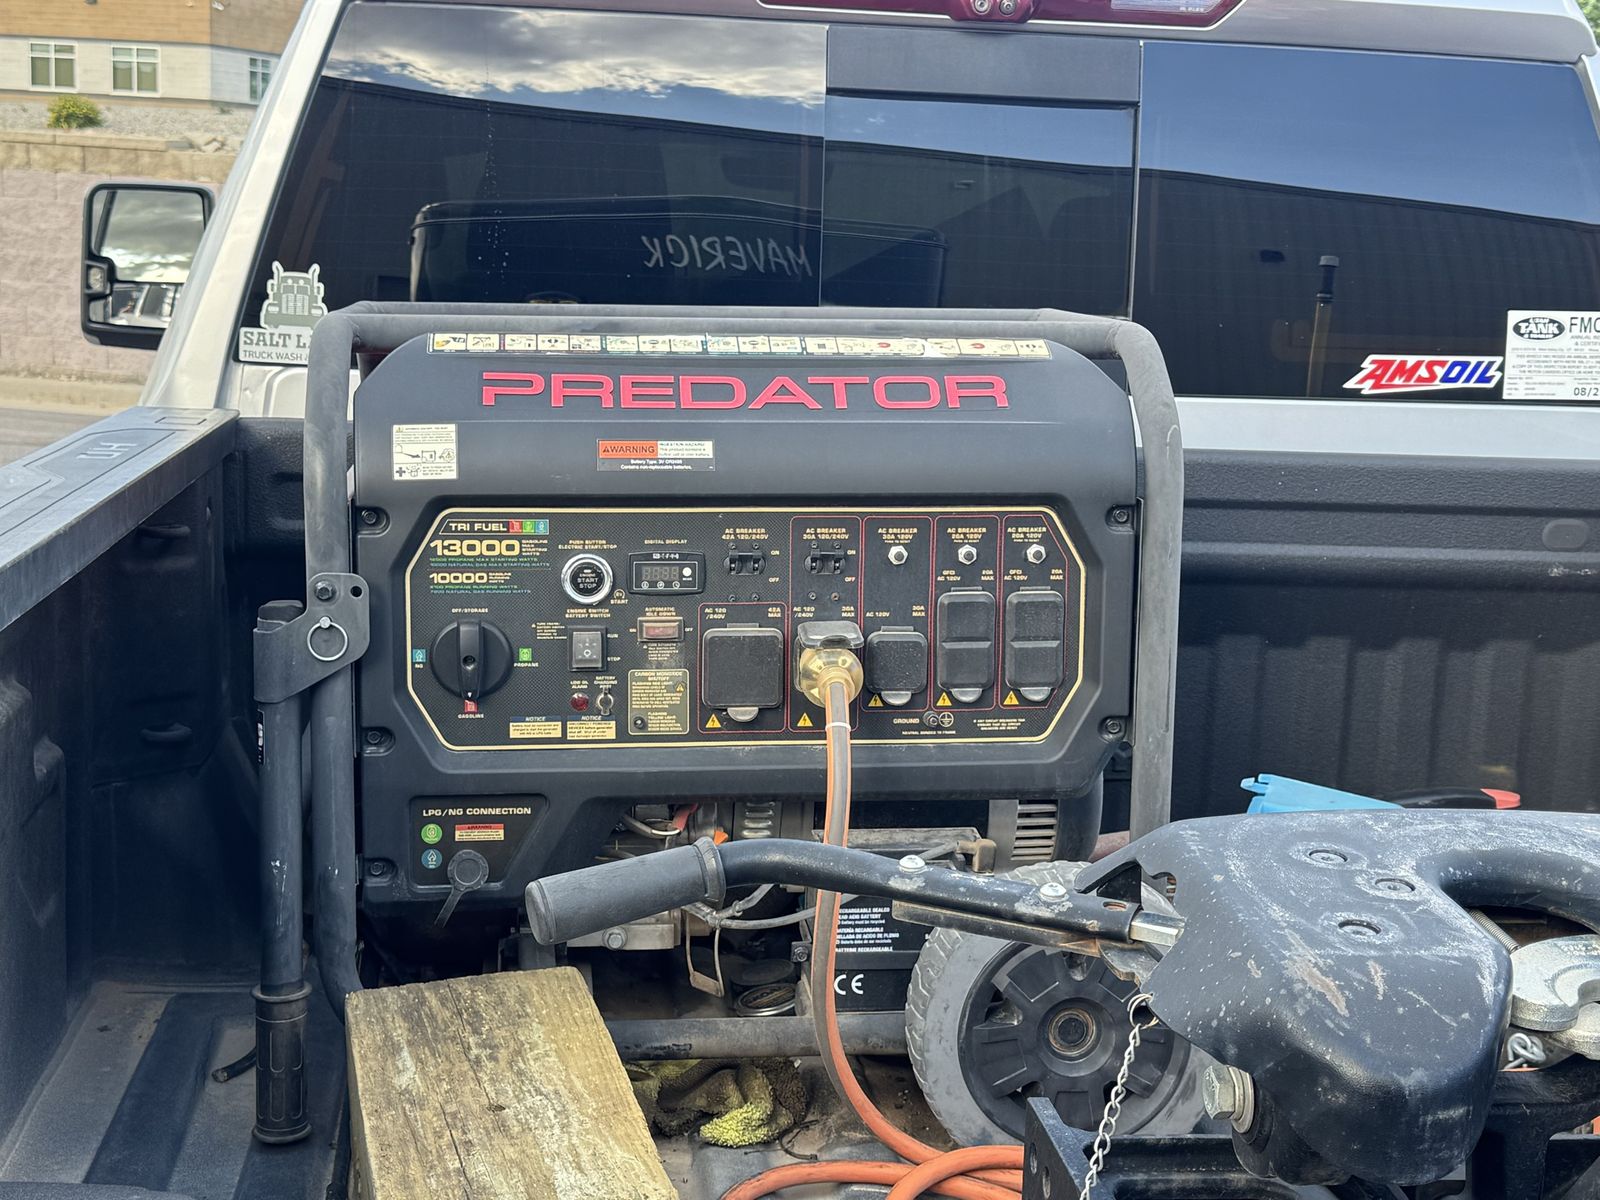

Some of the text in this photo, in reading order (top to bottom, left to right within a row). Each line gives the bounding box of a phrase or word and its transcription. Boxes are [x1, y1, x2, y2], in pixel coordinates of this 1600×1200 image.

[1518, 322, 1559, 334] TANK
[243, 331, 310, 349] SALT L
[243, 350, 274, 359] TRUCK
[275, 351, 302, 360] WASH
[1354, 359, 1497, 390] AMSOIL
[482, 372, 1009, 409] PREDATOR
[449, 523, 508, 531] TRI FUEL
[430, 539, 520, 556] 13000
[429, 573, 488, 583] 10000
[423, 807, 531, 817] LPG/NG CONNECTION
[833, 974, 864, 995] CE
